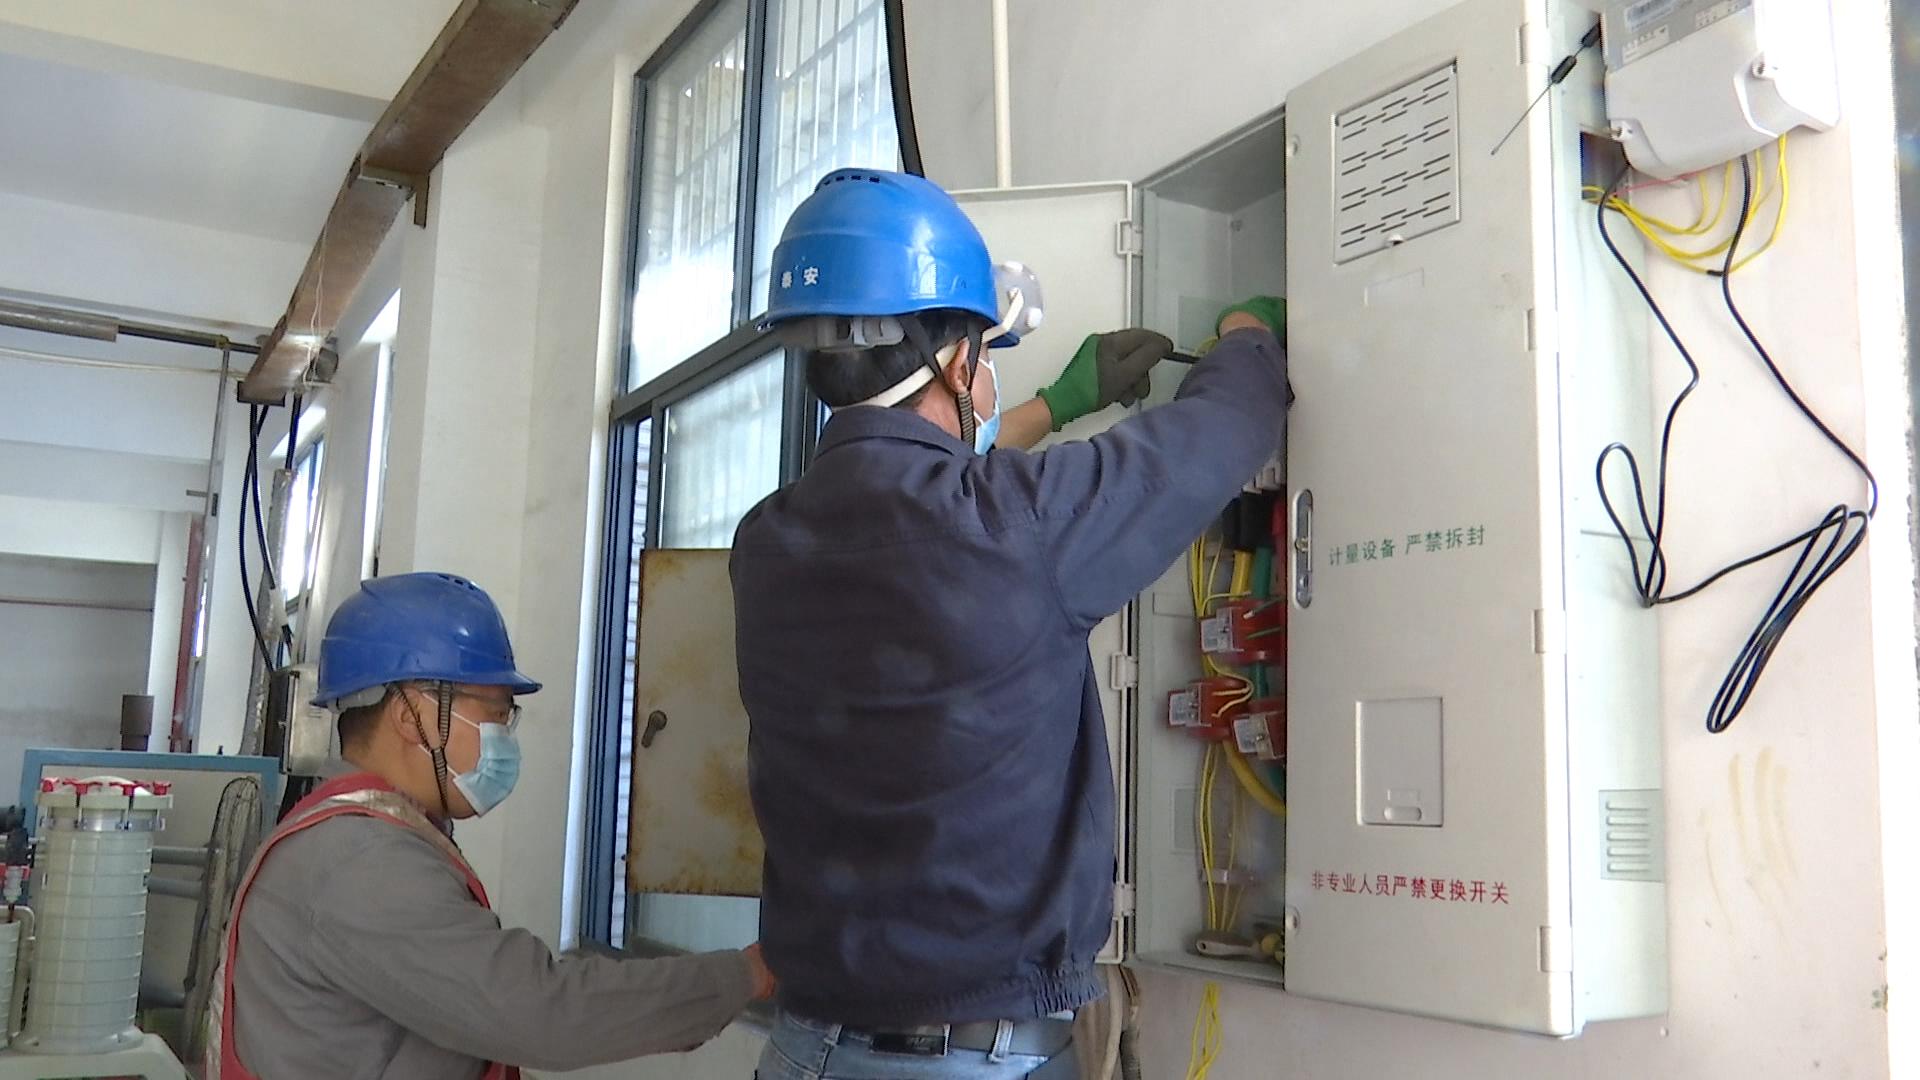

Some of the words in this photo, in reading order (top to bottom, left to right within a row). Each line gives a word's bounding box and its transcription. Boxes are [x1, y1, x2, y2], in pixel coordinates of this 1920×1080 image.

[1329, 538, 1396, 566] 计量设备
[1405, 524, 1485, 555] 严禁拆封
[1311, 869, 1510, 905] 非专业人员严禁更换开关
